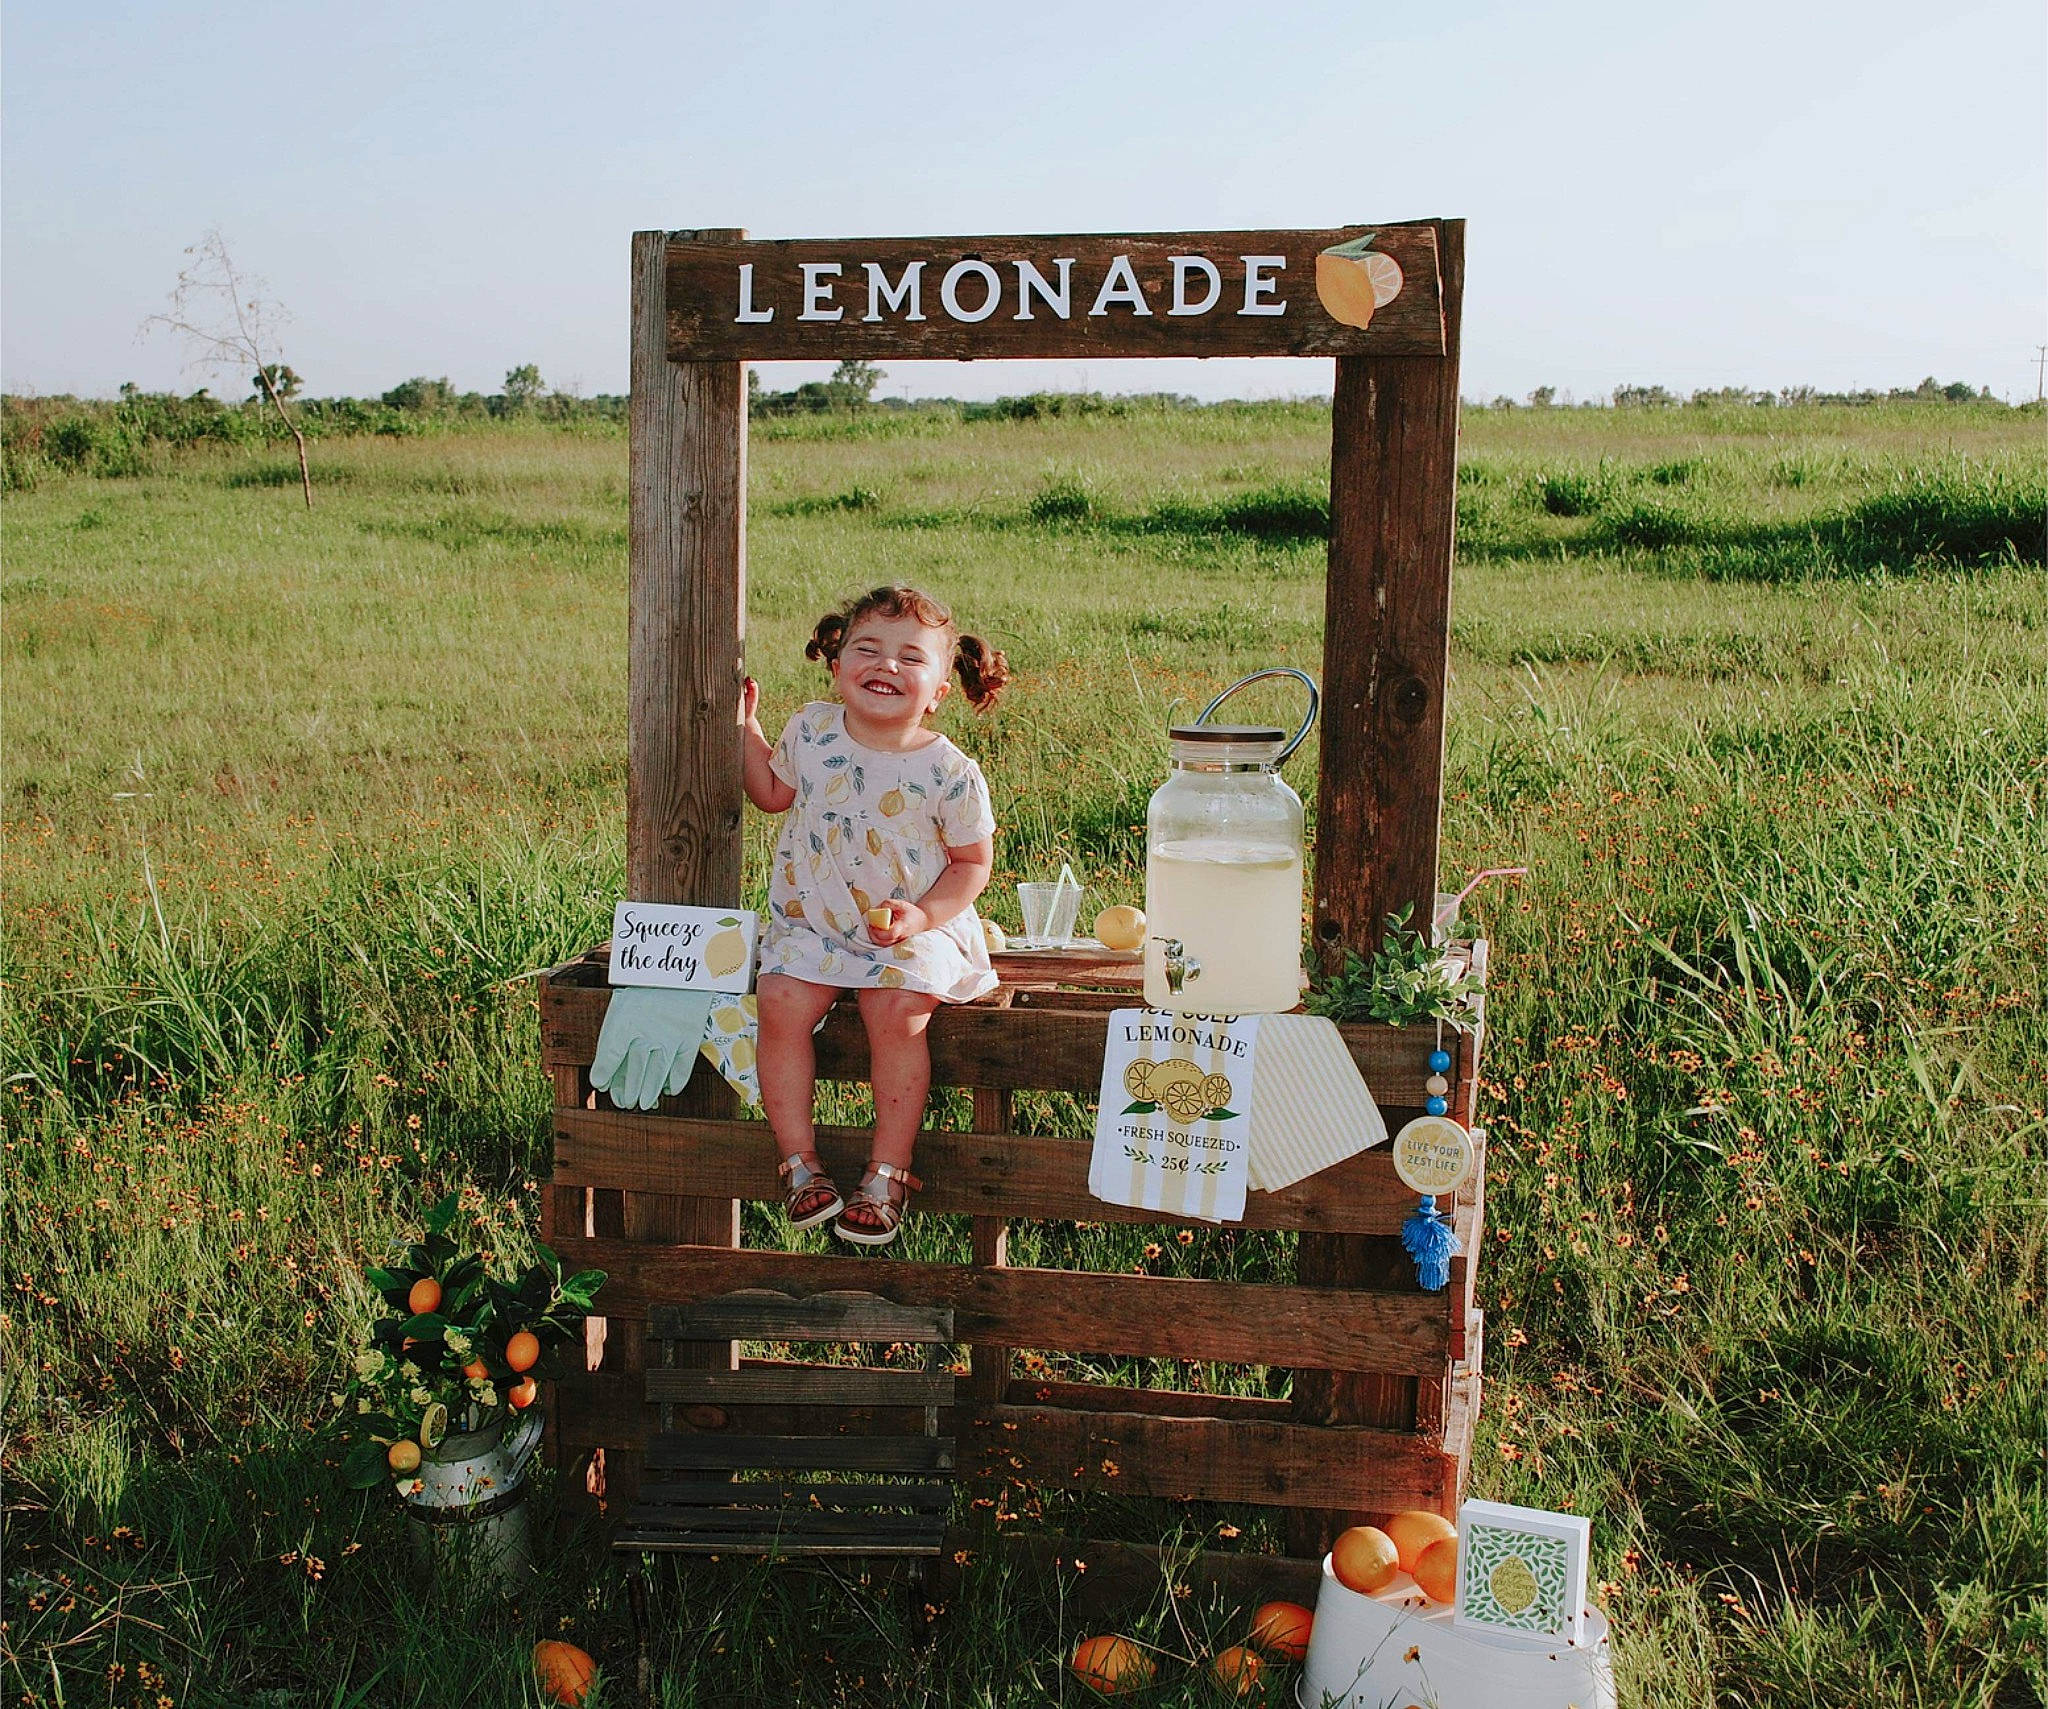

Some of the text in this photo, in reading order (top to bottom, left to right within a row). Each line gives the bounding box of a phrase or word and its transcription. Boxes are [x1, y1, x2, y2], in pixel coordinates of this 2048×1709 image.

[734, 254, 1287, 323] LEMONADE
[618, 911, 703, 946] Squeeze
[620, 944, 699, 982] the day
[1123, 1025, 1248, 1058] LEMONADE
[1123, 1125, 1235, 1152] FRESH SQUEEZED
[1408, 1140, 1459, 1157] LIVE YOUR
[1161, 1156, 1189, 1175] 25¢
[1407, 1155, 1457, 1171] ZEST LIFE
